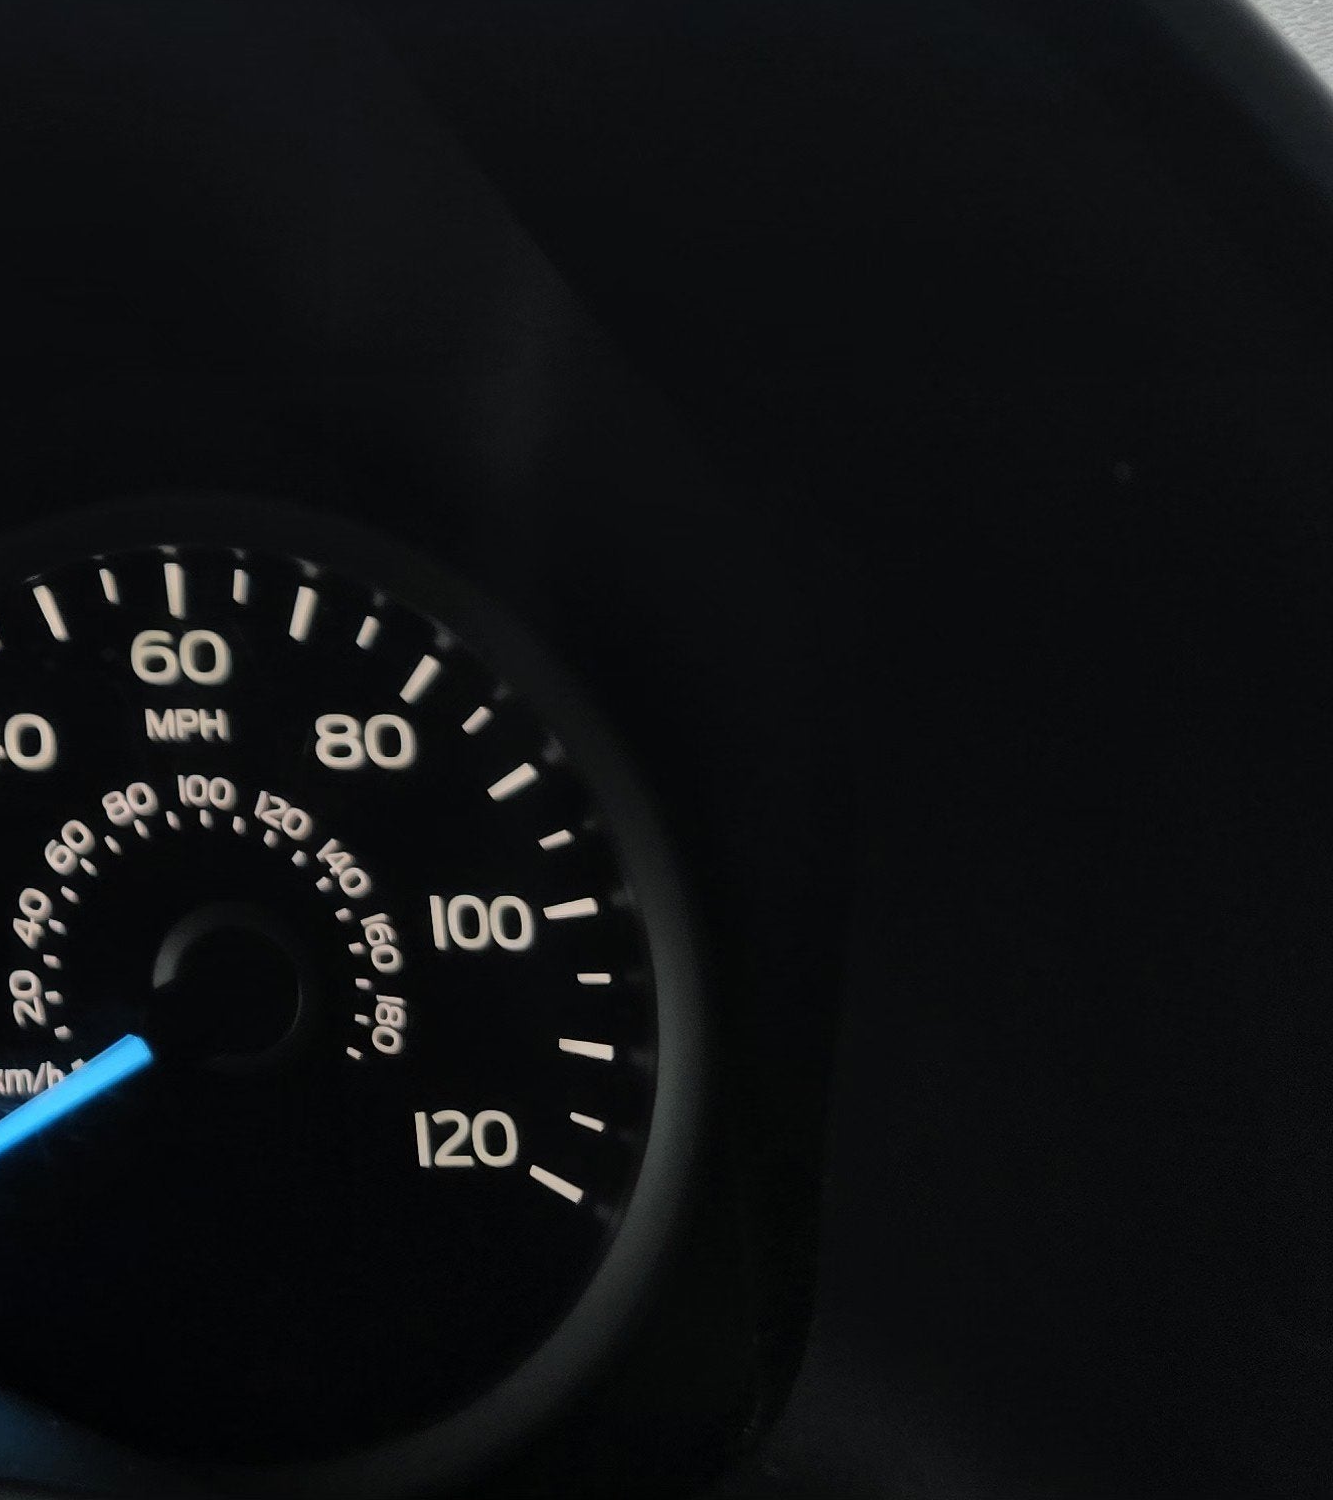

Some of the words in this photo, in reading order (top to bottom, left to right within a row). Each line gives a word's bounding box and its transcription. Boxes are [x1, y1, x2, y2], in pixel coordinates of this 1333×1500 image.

[130, 629, 231, 687] 60
[144, 708, 230, 742] MPH
[314, 713, 417, 771] 80
[101, 781, 160, 827] 80
[177, 774, 236, 812] 100
[254, 790, 314, 841] 120
[44, 819, 96, 876] 60
[316, 838, 371, 899] 140
[12, 887, 53, 950] 40
[360, 912, 404, 974] 160
[429, 894, 536, 952] 100
[9, 969, 47, 1028] 20
[371, 995, 407, 1055] 180
[414, 1109, 520, 1169] 120
